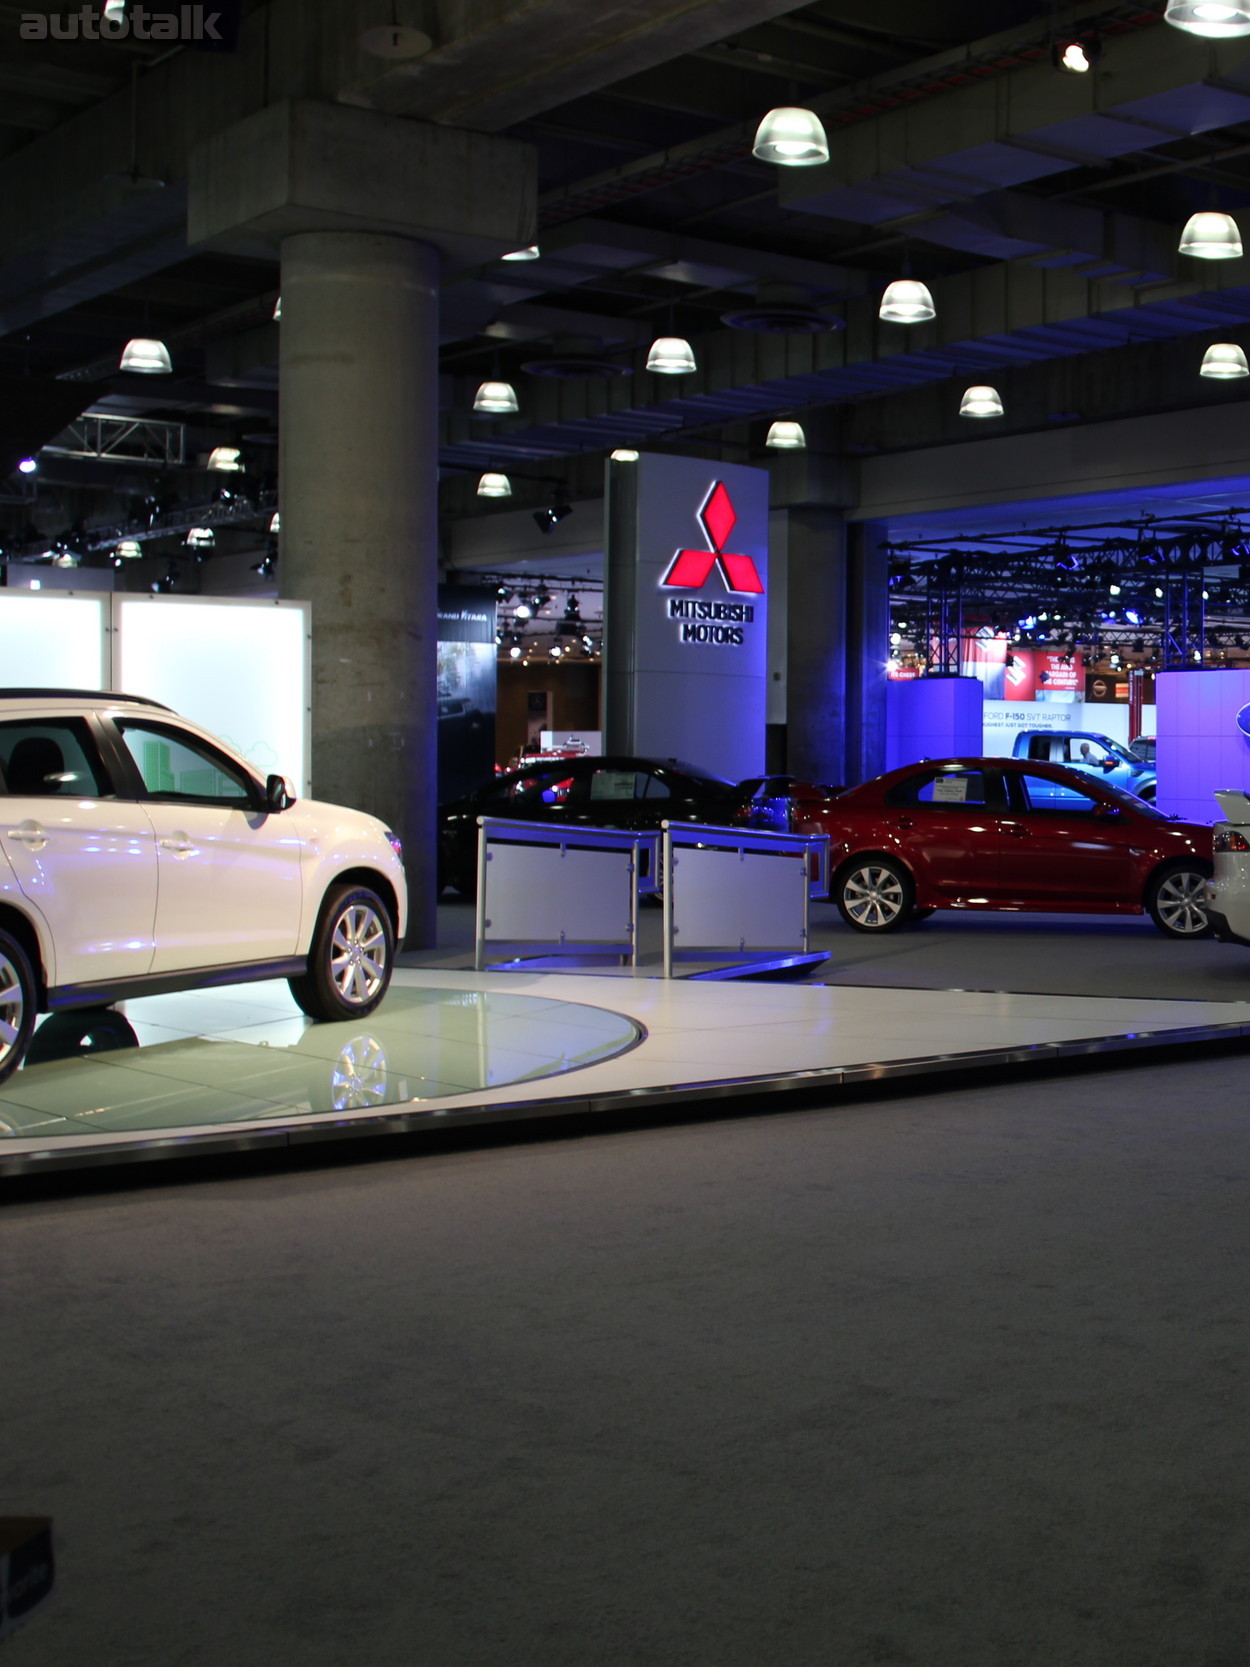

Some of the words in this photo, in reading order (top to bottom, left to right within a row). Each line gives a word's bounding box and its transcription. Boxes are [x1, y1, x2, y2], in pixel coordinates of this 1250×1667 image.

[668, 599, 754, 623] MITSUBISHI
[681, 624, 744, 645] MOTORS
[983, 712, 1004, 720] FORD
[1005, 712, 1026, 720] F-150
[1026, 713, 1040, 721] SVT
[1042, 713, 1071, 722] RAPTOR
